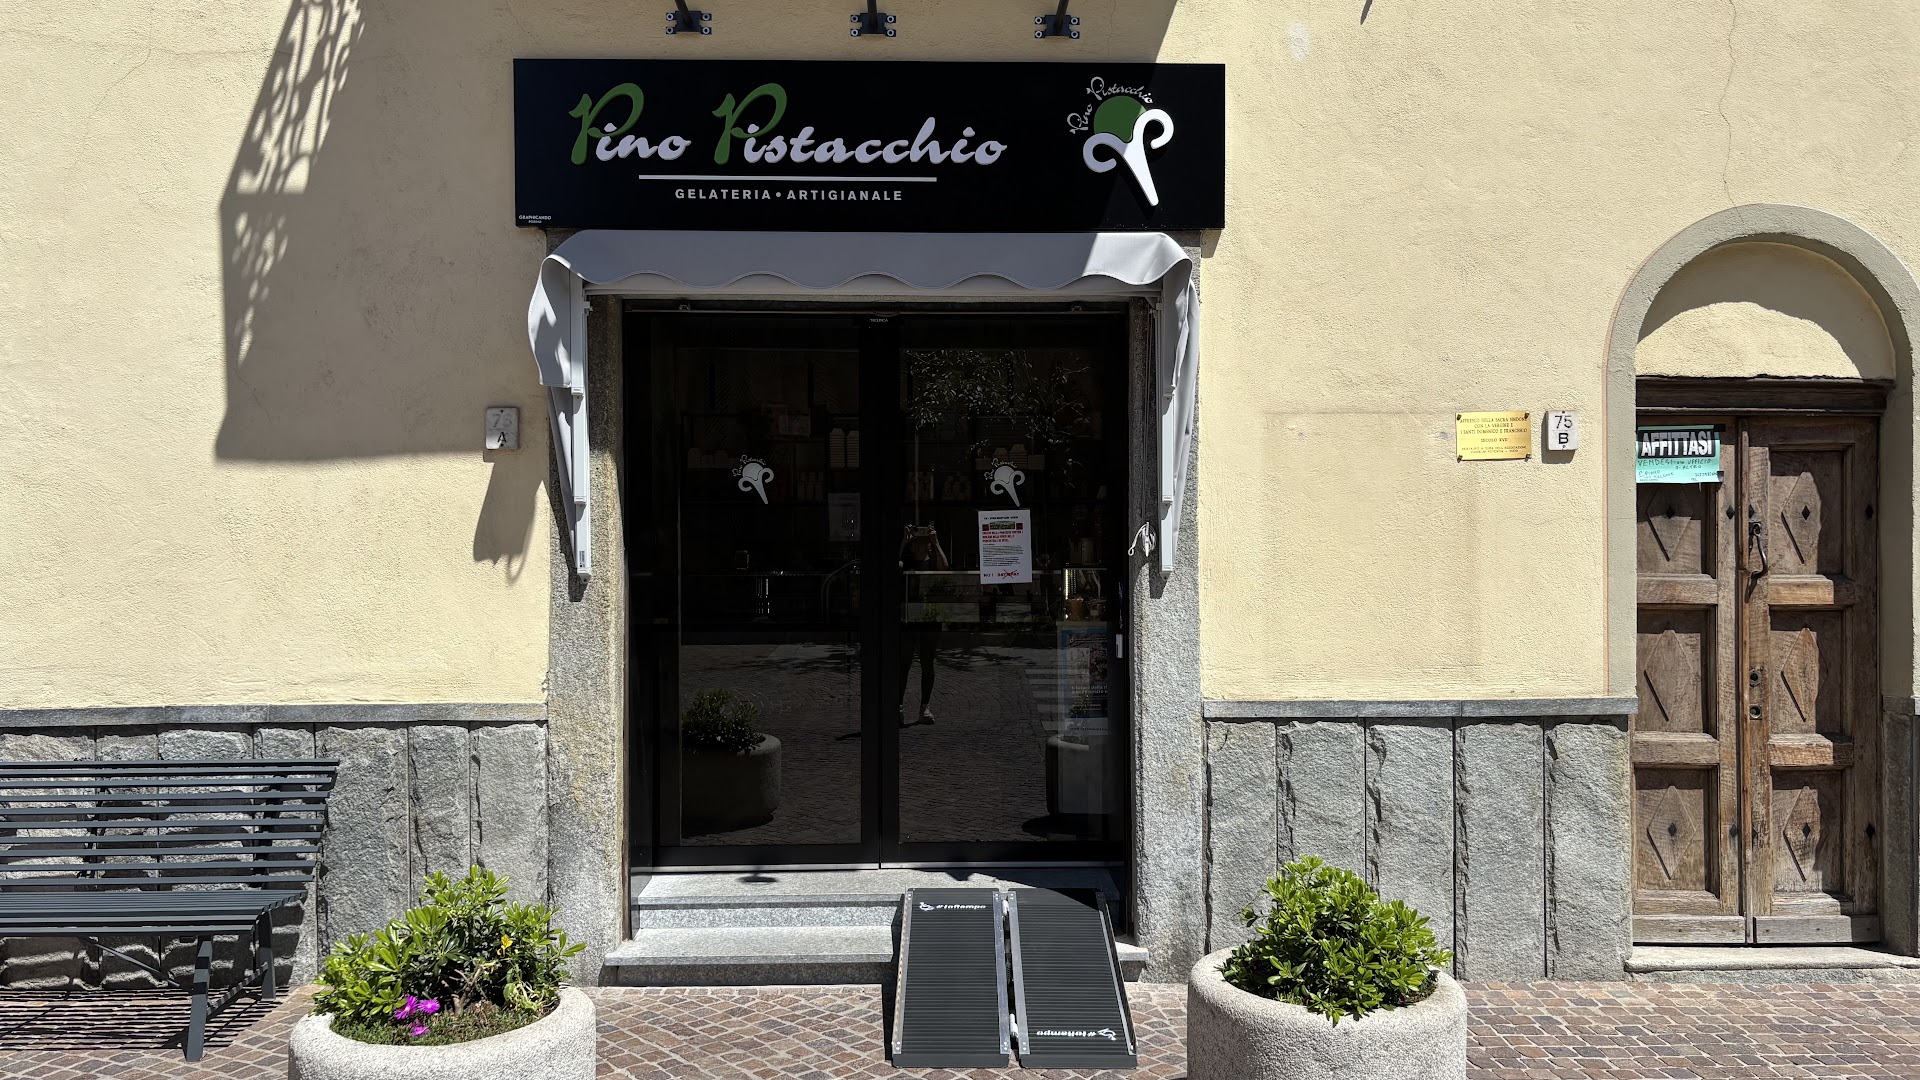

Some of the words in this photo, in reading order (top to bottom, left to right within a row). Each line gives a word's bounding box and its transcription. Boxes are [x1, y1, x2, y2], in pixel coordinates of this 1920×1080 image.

[1066, 103, 1093, 135] Pino
[1086, 76, 1154, 105] Pistacchio
[568, 82, 692, 166] Pino
[711, 82, 1008, 166] Pistacchio
[674, 188, 771, 200] GELATERIA
[786, 190, 903, 201] ARTIGIANALE
[1555, 415, 1573, 429] 75
[497, 431, 507, 443] A
[1558, 432, 1569, 444] B
[1640, 430, 1713, 456] AFFITTASI
